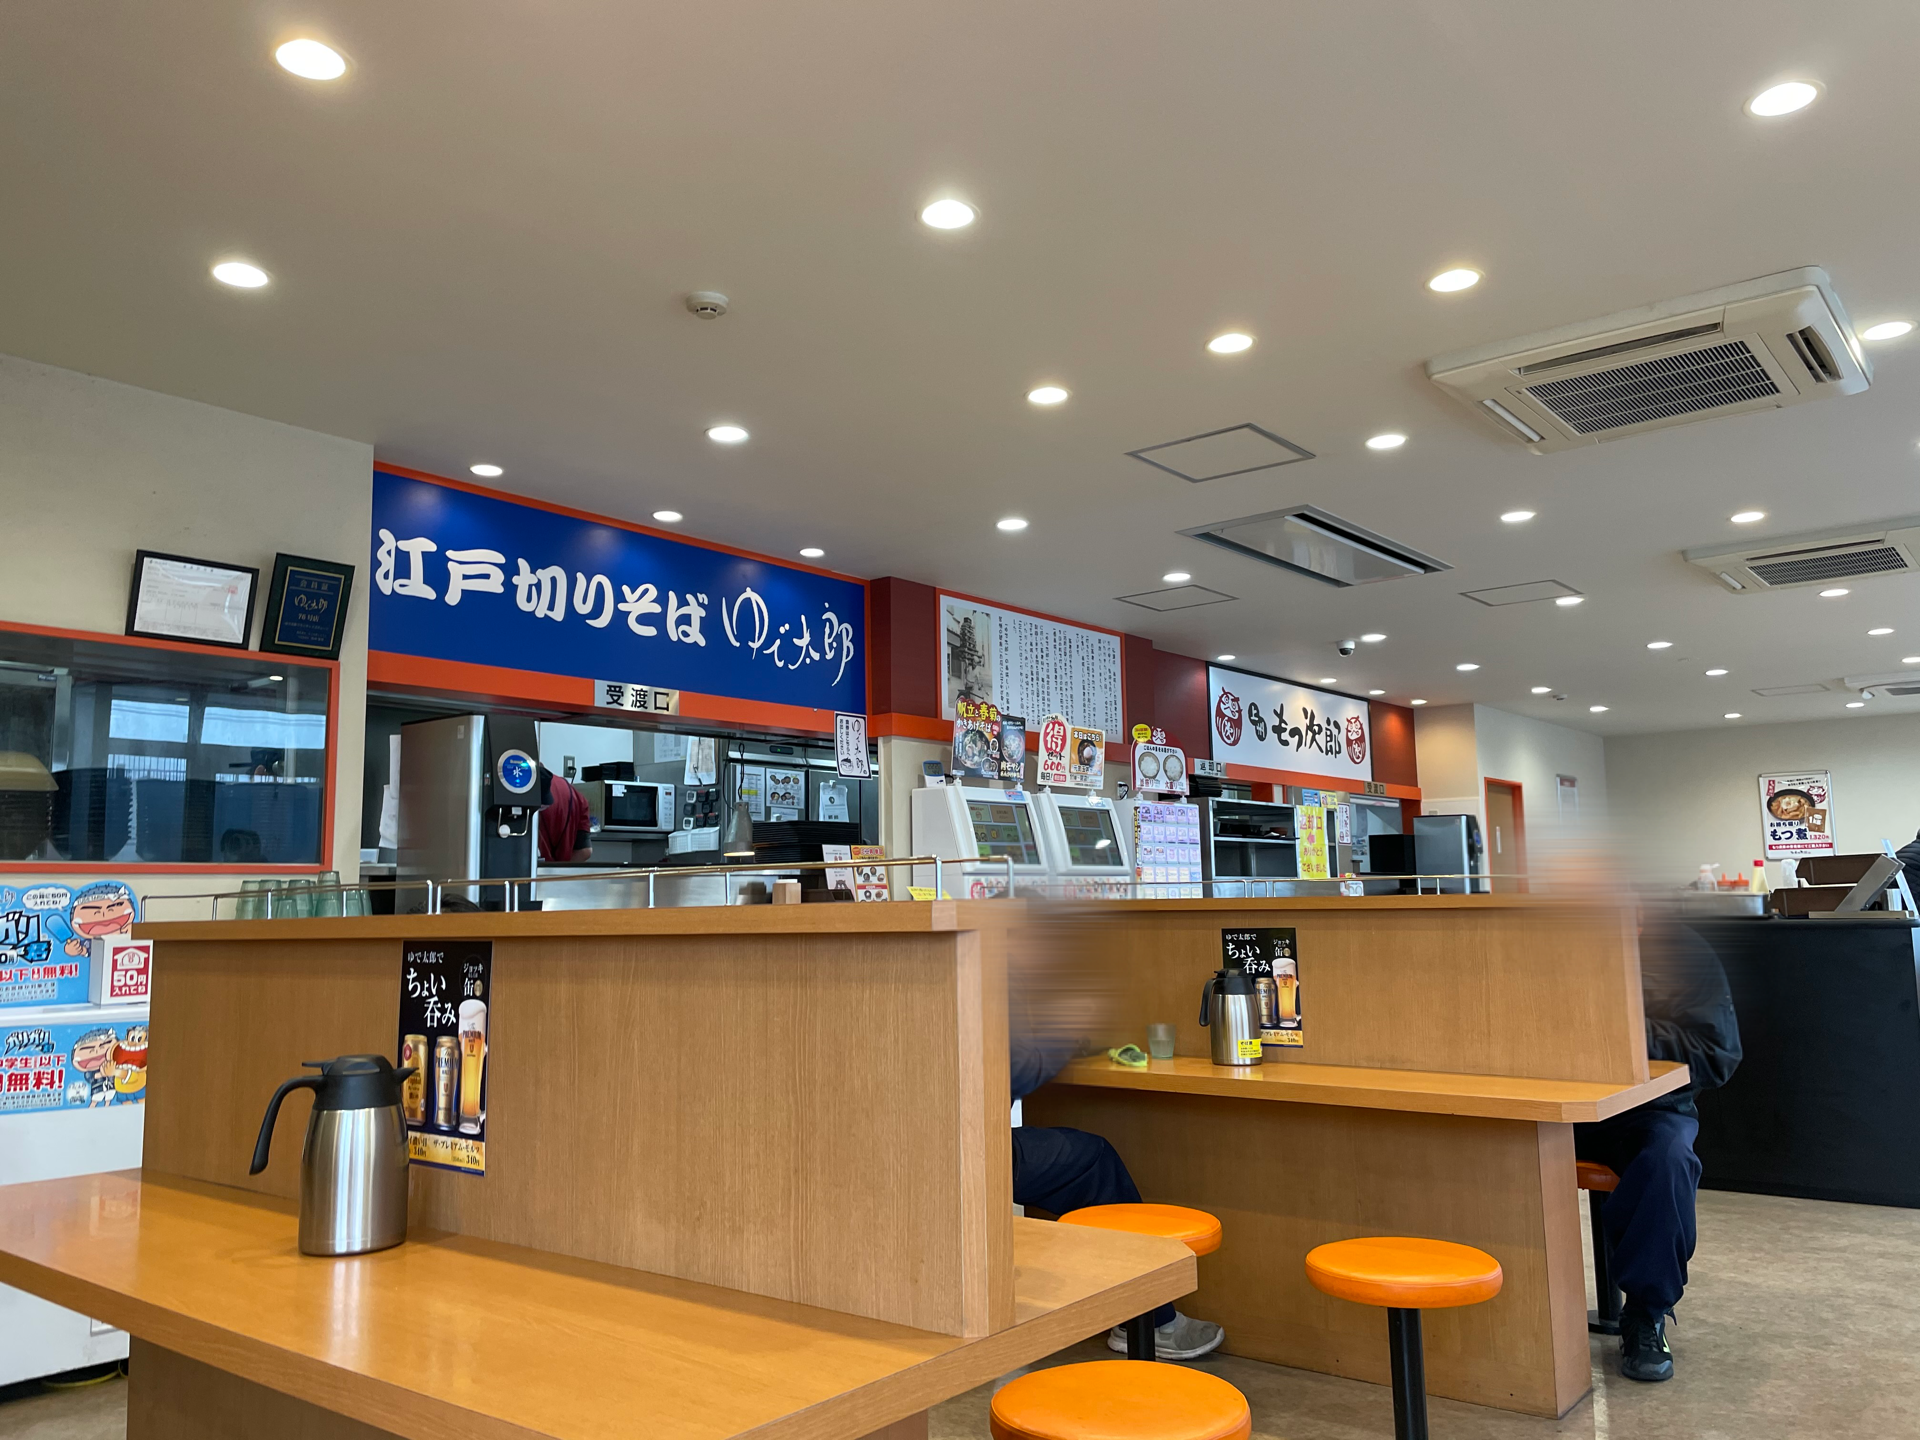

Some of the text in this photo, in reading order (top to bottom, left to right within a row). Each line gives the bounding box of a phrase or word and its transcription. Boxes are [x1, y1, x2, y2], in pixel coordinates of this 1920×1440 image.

[375, 528, 709, 648] 江戸切りそば
[722, 586, 855, 687] ゆで太郎
[606, 684, 671, 712] 受渡口
[957, 700, 1001, 722] 帆立と春菊の
[956, 718, 992, 733] かきあげそば
[1271, 703, 1342, 759] もつ次郎
[1046, 723, 1064, 752] 得
[1073, 730, 1102, 742] 本日はこちら!
[1047, 751, 1065, 761] セット
[1043, 760, 1065, 772] 600円
[1200, 761, 1221, 773] 返却口
[1366, 782, 1384, 795] 受渡口
[1299, 814, 1323, 831] 返却口
[1770, 820, 1799, 828] お持ち帰り
[1770, 827, 1808, 841] もつ煮
[1303, 846, 1323, 857] ありがとう
[1302, 862, 1327, 873] ございました
[33, 899, 62, 908] 入れてね!
[1226, 933, 1257, 941] ゆで太郎で
[407, 950, 444, 964] ゆで太郎で
[1226, 942, 1260, 959] ちょい
[463, 962, 484, 974] ジョッキ
[1243, 957, 1271, 974] 呑み
[114, 970, 147, 986] 50円
[406, 967, 446, 998] ちょい
[113, 985, 147, 995] 入れてね
[463, 977, 474, 997] 缶
[423, 996, 457, 1028] 呑み
[433, 1138, 480, 1153] ザ・プレミアム・モルツ
